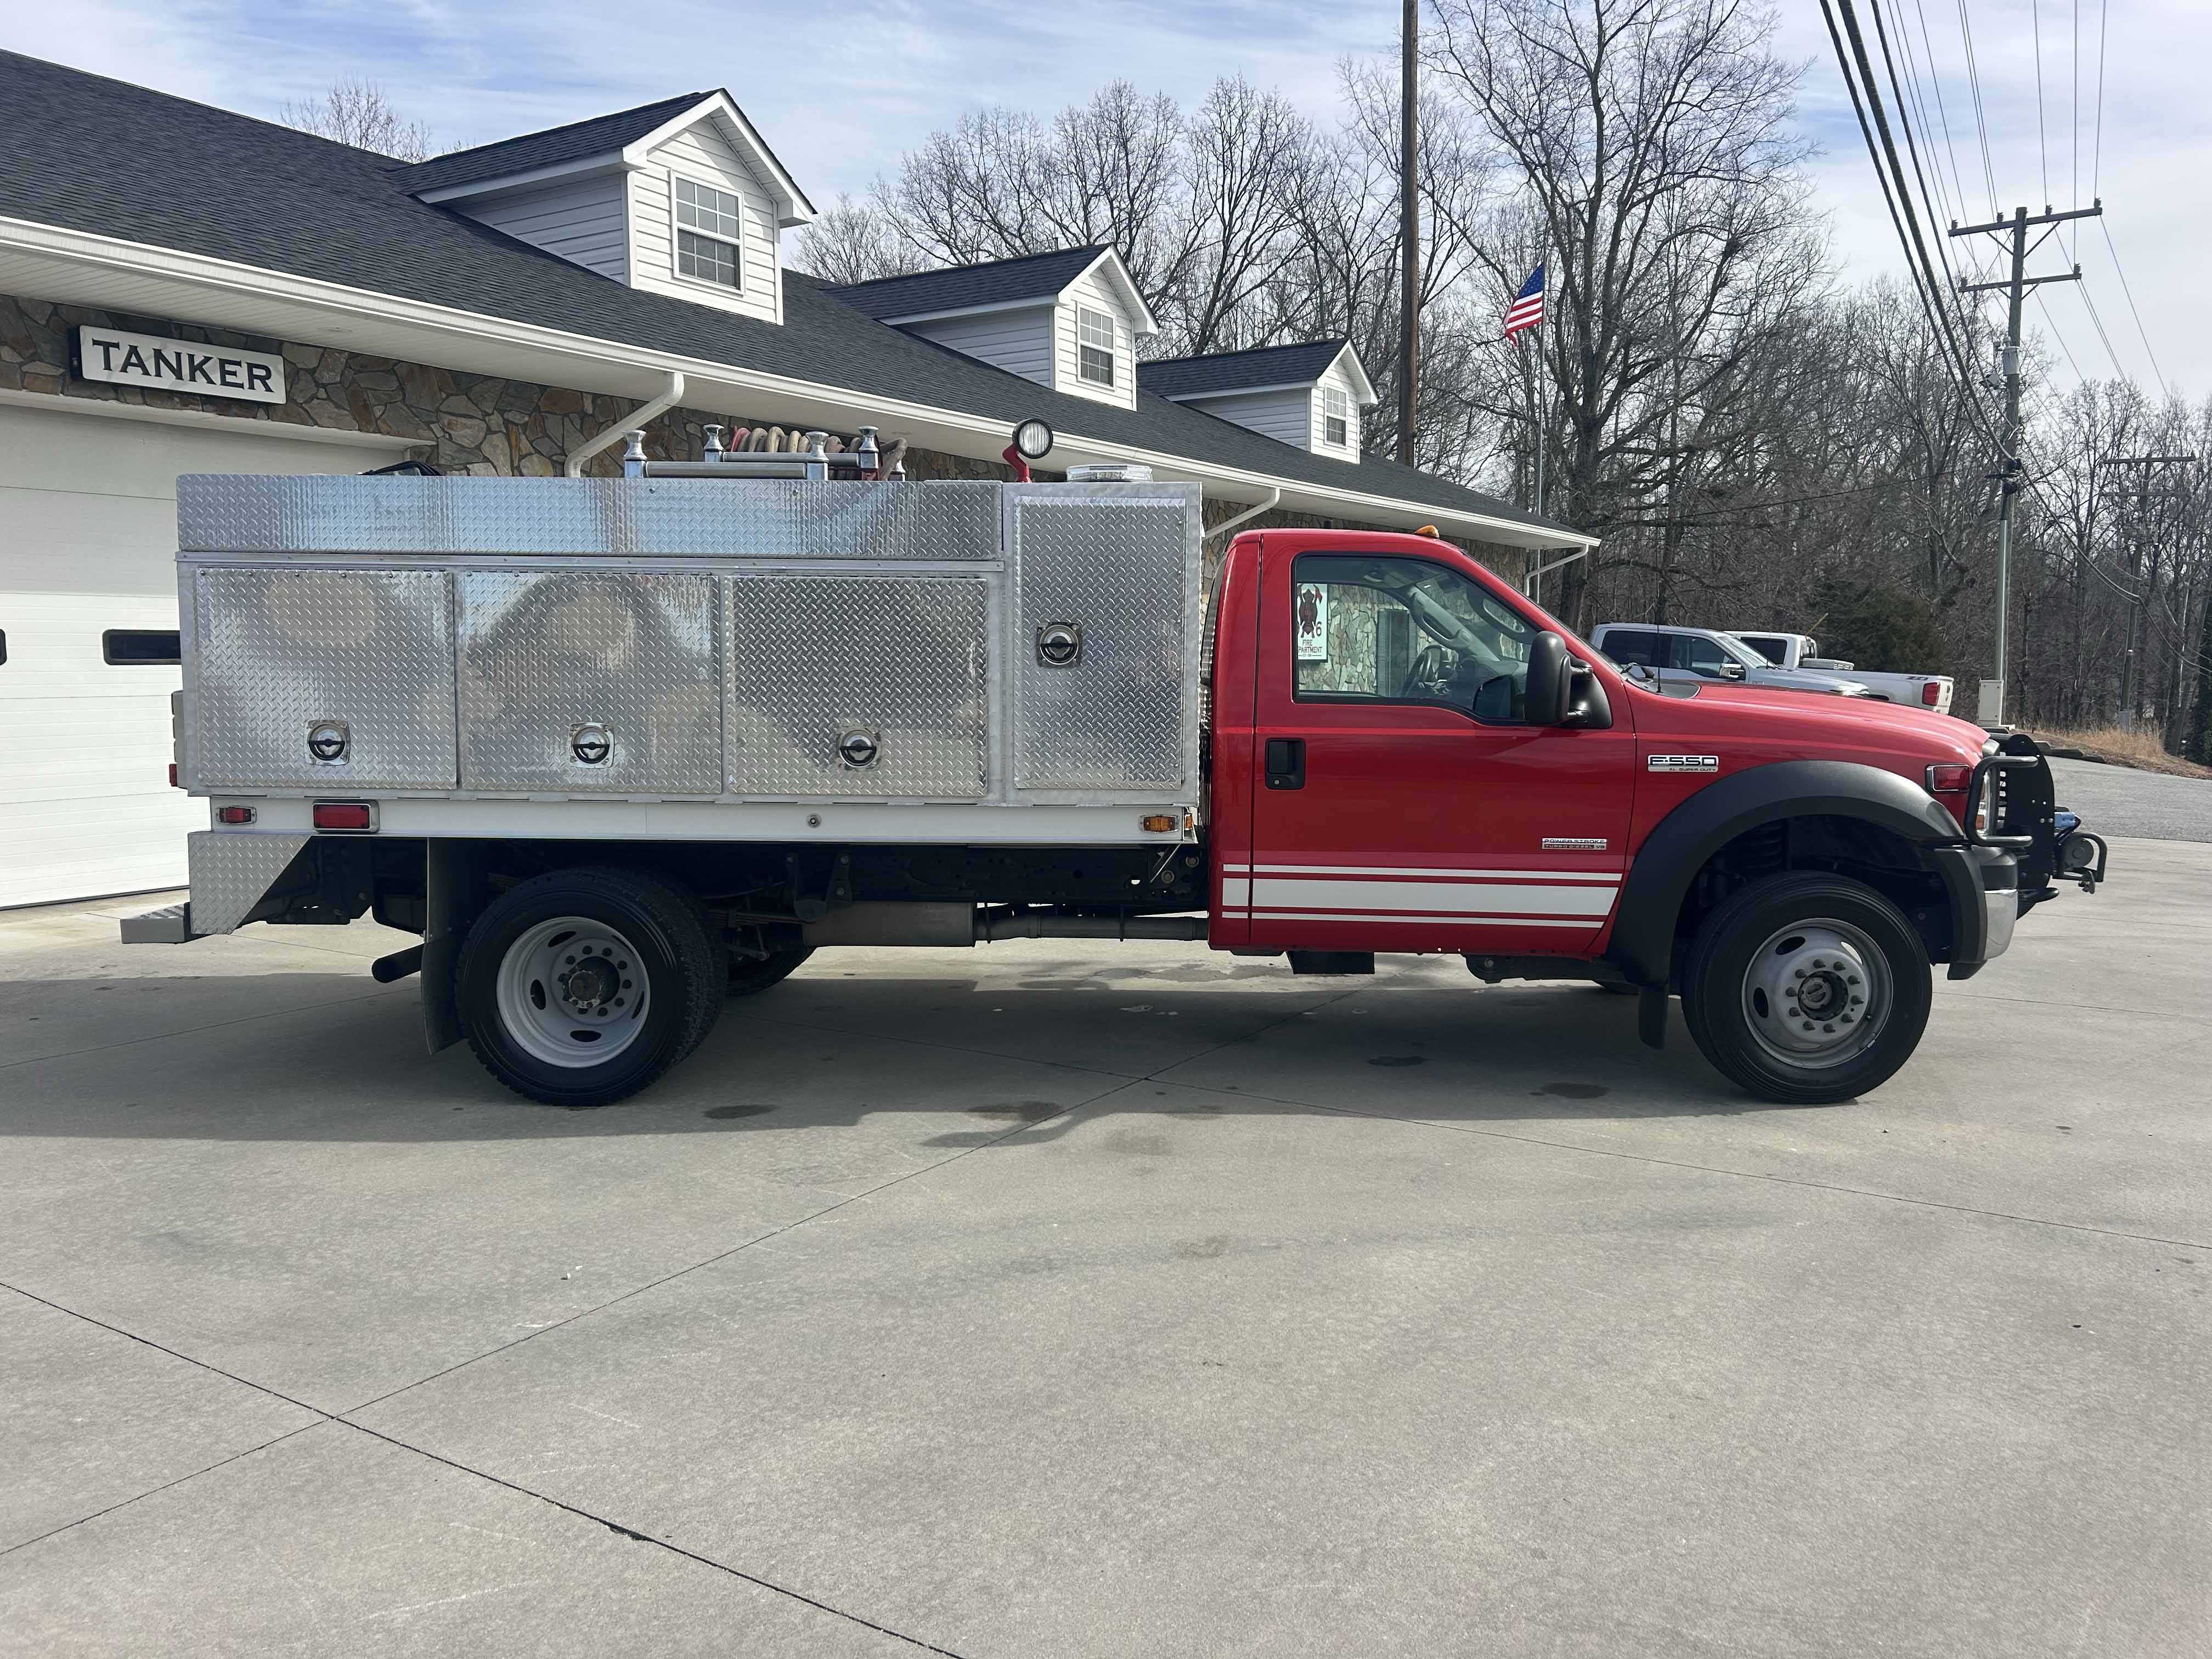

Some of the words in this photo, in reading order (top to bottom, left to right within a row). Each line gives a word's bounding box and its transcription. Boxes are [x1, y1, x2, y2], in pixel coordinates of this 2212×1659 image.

[92, 337, 274, 393] TANKER
[1316, 621, 1322, 637] 6
[1650, 757, 1716, 766] F-550
